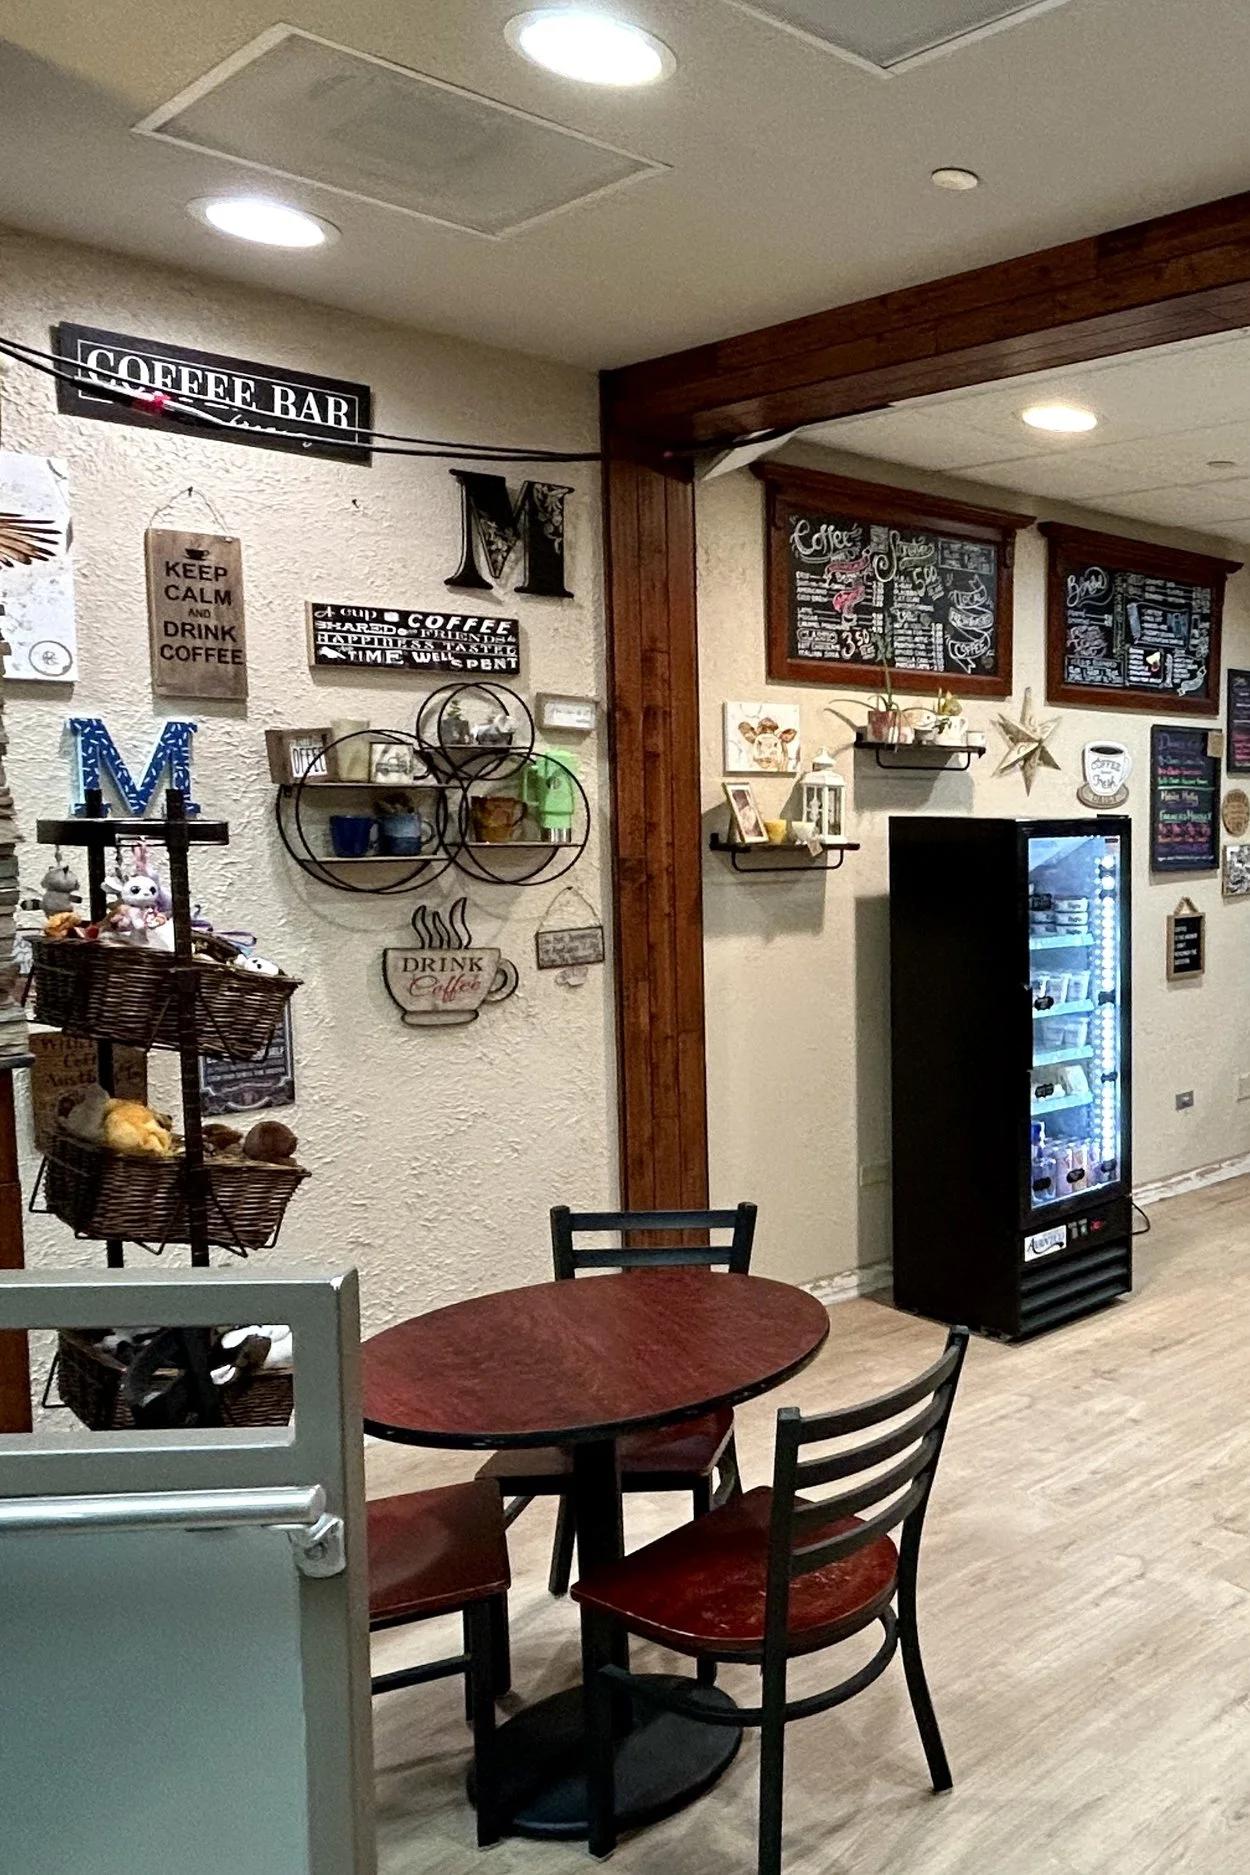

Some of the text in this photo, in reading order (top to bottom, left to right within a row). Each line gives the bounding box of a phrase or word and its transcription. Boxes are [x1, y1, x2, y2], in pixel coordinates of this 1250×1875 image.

[86, 347, 351, 429] COFFEE BAR
[444, 468, 575, 600] M
[794, 519, 855, 556] Coffee
[165, 560, 228, 582] KEEP
[164, 584, 232, 607] CALM
[188, 608, 211, 618] AND
[314, 606, 336, 619] A
[340, 608, 377, 622] cup
[407, 613, 511, 635] COFFEE
[163, 621, 237, 642] DRINK
[315, 620, 396, 636] SHARED
[419, 628, 506, 643] FRIENDS
[316, 633, 436, 650] HAPPINESS
[160, 643, 245, 666] COFFEE
[348, 649, 404, 665] TIME
[411, 651, 455, 664] WELL
[450, 657, 518, 671] SPENT
[68, 717, 200, 815] M
[402, 957, 483, 972] DRINK
[409, 973, 482, 1003] Coffee
